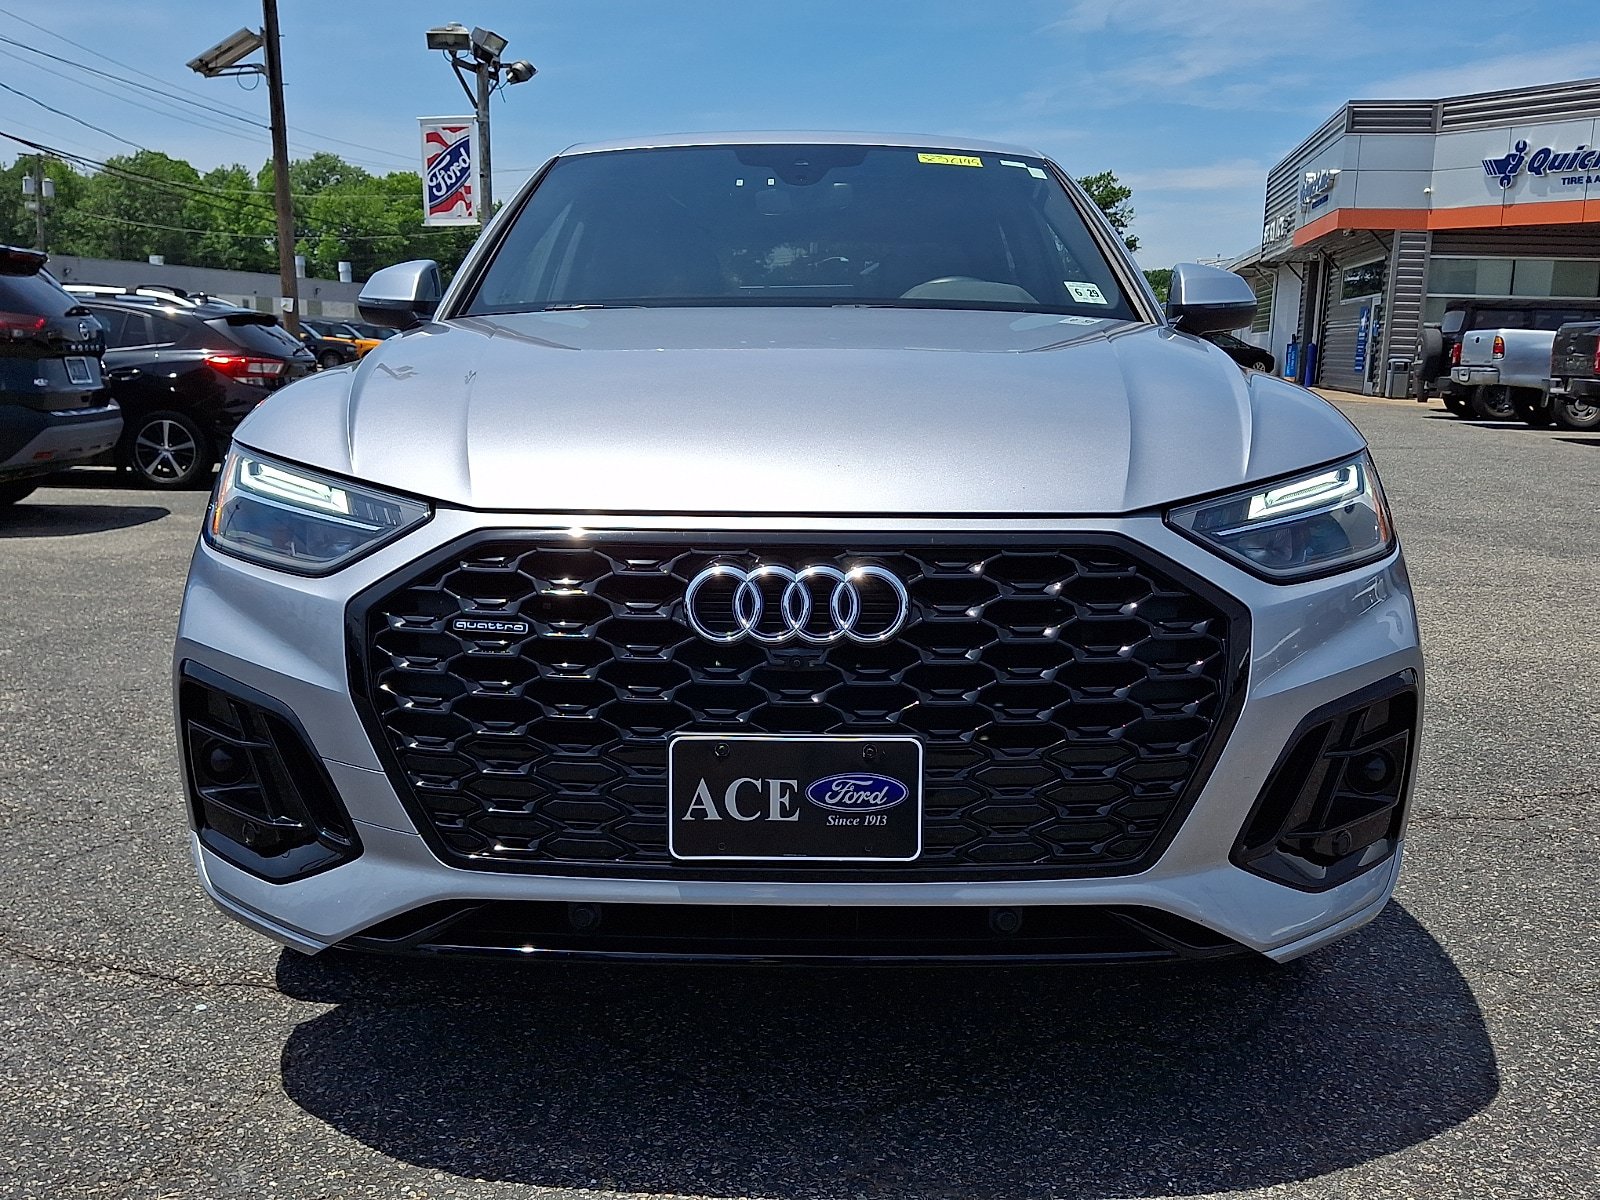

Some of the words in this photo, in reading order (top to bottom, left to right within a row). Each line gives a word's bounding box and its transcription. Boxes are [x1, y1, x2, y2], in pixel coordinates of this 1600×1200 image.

[428, 147, 470, 196] Ford
[1561, 176, 1584, 186] TIRE
[1586, 175, 1593, 184] &
[1074, 288, 1083, 297] 6
[1087, 288, 1100, 298] 29
[455, 621, 524, 631] quattro
[681, 777, 800, 822] ACE
[825, 779, 889, 805] Ford
[826, 815, 860, 827] Since
[864, 815, 888, 827] 1913
